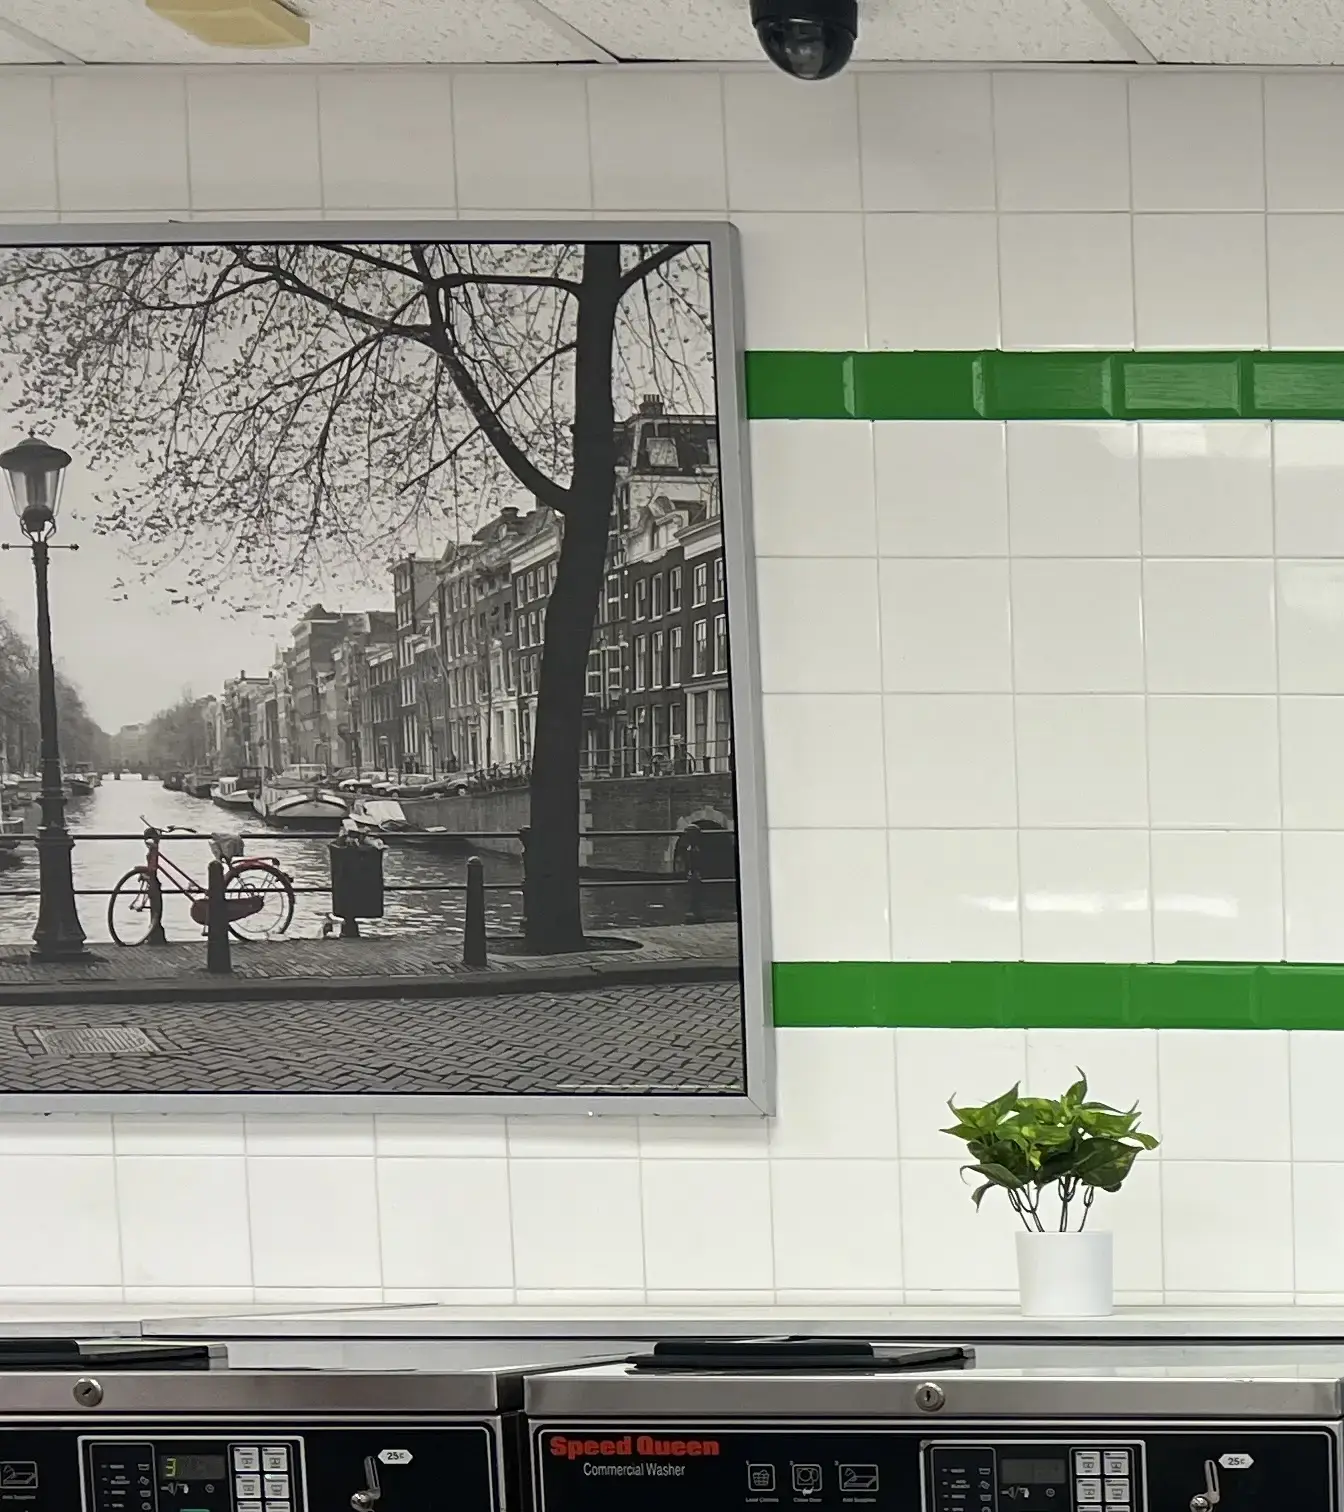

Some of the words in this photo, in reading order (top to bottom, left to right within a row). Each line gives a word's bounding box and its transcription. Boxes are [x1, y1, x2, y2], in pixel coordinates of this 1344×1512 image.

[550, 1436, 632, 1459] Speed
[636, 1436, 719, 1456] Queen
[583, 1462, 644, 1476] Commercial
[645, 1462, 685, 1476] Washer
